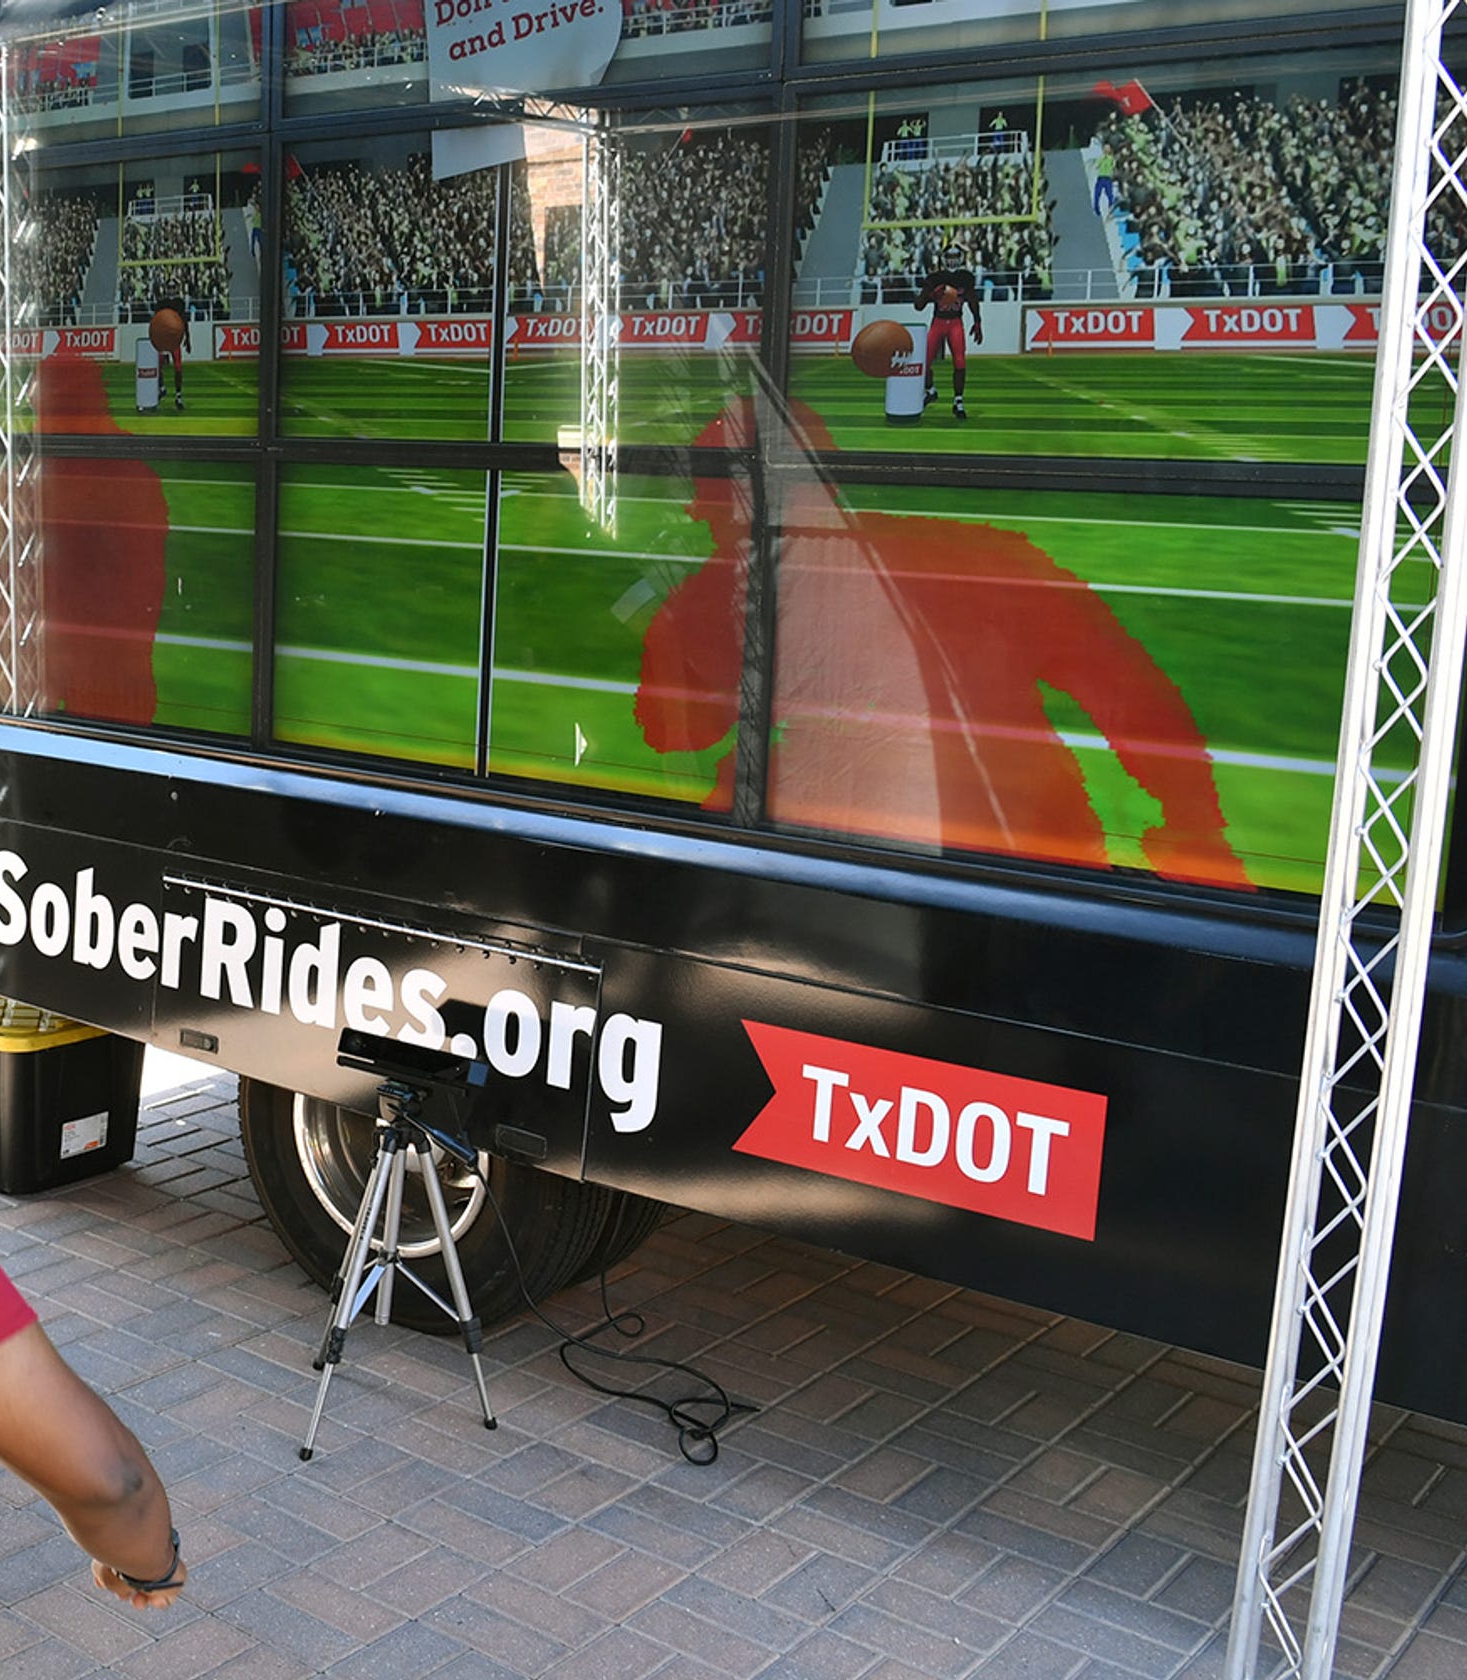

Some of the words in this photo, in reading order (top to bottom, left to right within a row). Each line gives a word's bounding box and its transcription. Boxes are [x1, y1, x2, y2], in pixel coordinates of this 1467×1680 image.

[449, 21, 506, 61] and
[511, 0, 604, 41] Drive.
[632, 316, 700, 336] TxDOT
[1053, 310, 1144, 334] TxDOT
[1203, 308, 1302, 333] TxDOT
[65, 331, 109, 348] TxDOT
[334, 325, 391, 343] TxDOT
[427, 323, 488, 342] TxDOT
[802, 1063, 1070, 1196] TxDOT
